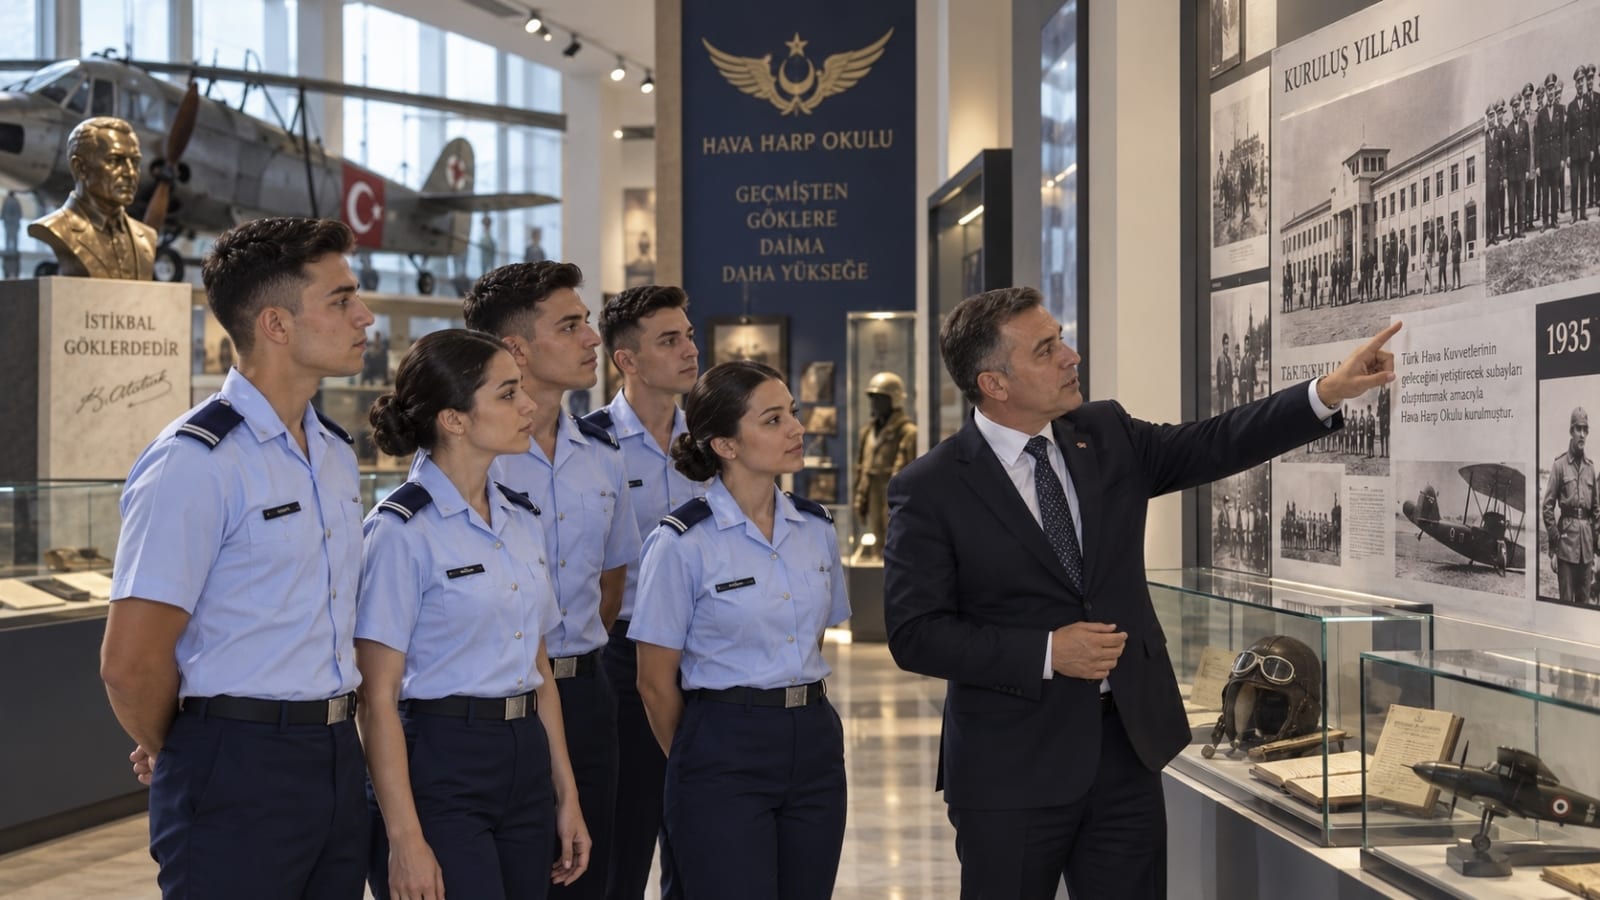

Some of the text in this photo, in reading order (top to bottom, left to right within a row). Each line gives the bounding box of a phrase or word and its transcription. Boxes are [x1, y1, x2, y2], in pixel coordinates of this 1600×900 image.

[1284, 15, 1420, 93] KURULUŞ YILLARI
[702, 129, 894, 155] HAVA HARP OKULU
[736, 180, 849, 204] GEÇMİŞTEN
[746, 208, 838, 229] GÖKLERE
[760, 234, 825, 256] DAİMA
[722, 260, 869, 283] DAHA YÜKSEĞE
[84, 310, 156, 331] İSTİKBAL
[63, 336, 179, 356] GÖKLERDEDİR
[1547, 317, 1591, 355] 1935
[1401, 342, 1497, 366] Türk Hava Kuvvetlerinin
[1440, 365, 1484, 385] yetiştirecek
[1486, 362, 1523, 380] subayları
[1449, 386, 1484, 403] amacıyla
[1401, 410, 1419, 424] Hava
[1440, 408, 1463, 422] Okulu
[1464, 406, 1514, 422] kurulmuştur.
